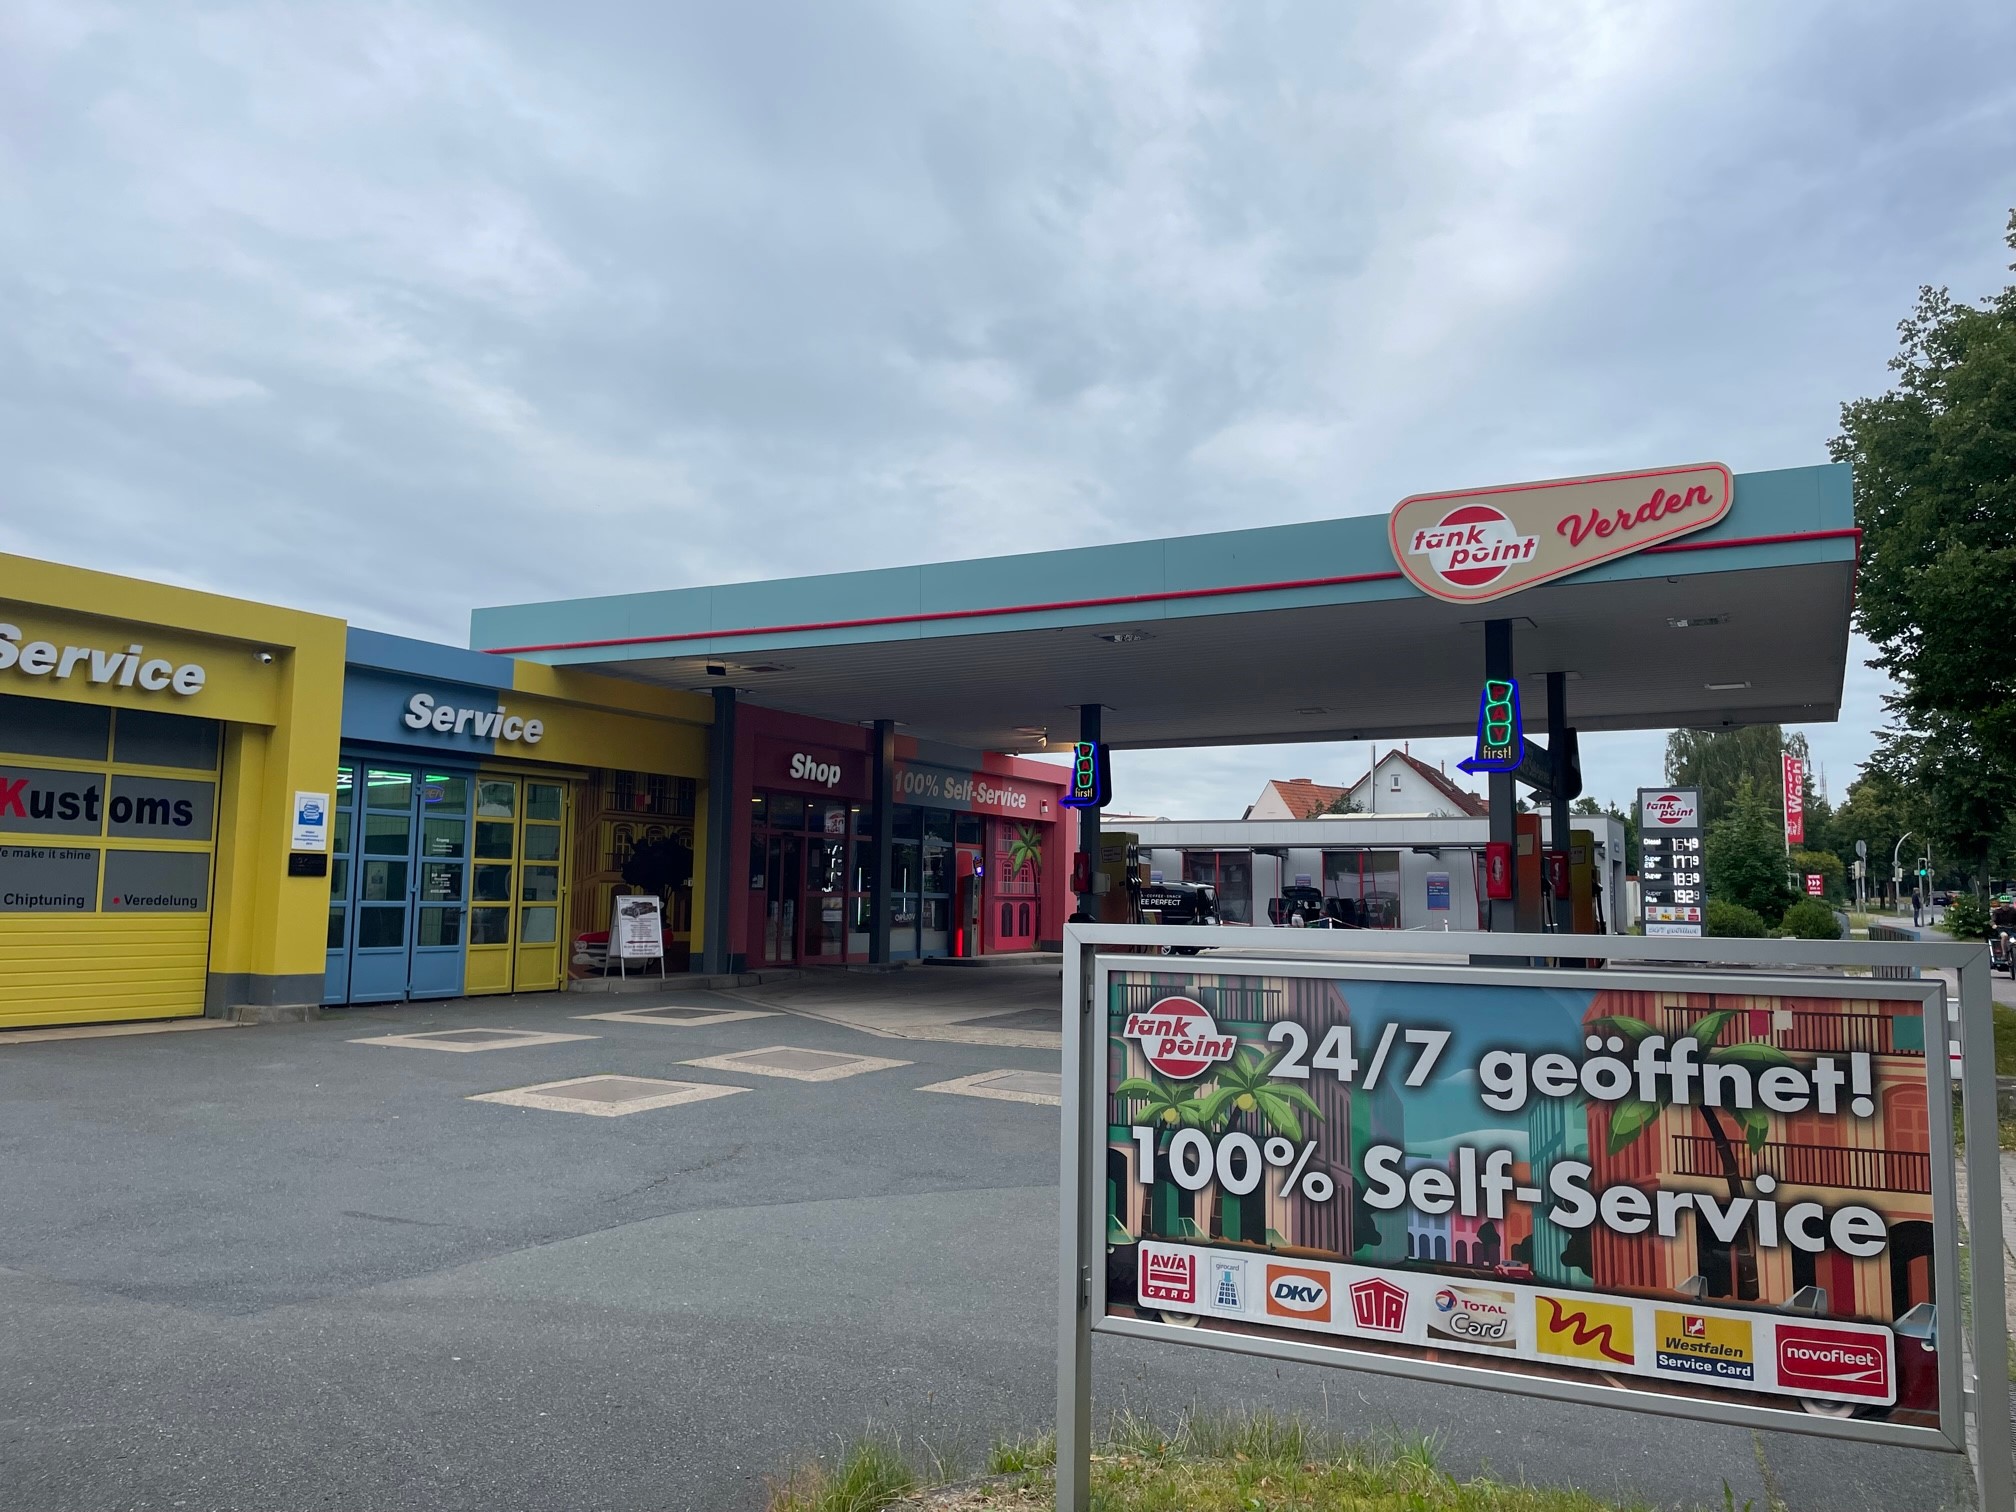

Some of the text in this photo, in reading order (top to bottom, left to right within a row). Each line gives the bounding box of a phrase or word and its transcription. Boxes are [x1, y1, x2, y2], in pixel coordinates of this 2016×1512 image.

[1556, 485, 1713, 548] Verden
[1414, 524, 1487, 551] tank
[1448, 537, 1536, 570] point
[0, 623, 206, 696] Service
[404, 693, 545, 744] Service
[1483, 744, 1513, 760] first!
[789, 752, 842, 789] Shop
[894, 770, 1027, 809] 100% Self-Service
[1075, 787, 1093, 798] first!
[1646, 802, 1675, 810] tank
[1660, 808, 1693, 818] point
[12, 848, 45, 860] make
[48, 850, 58, 860] it
[59, 849, 92, 861] shine
[1673, 872, 1700, 886] 1839
[4, 892, 199, 910] Chiptuning Veredelung
[1673, 889, 1700, 903] 1929
[1127, 1014, 1189, 1037] tank
[1157, 1033, 1235, 1058] point
[1267, 1020, 1876, 1118] 24/7 geöffnet!
[1131, 1125, 1888, 1258] 100% Self-Service
[1215, 1262, 1240, 1272] girocard
[1147, 1286, 1190, 1300] CARD
[1274, 1282, 1324, 1304] DKV
[1353, 1280, 1404, 1330] UTA
[1450, 1312, 1508, 1339] Card
[1665, 1336, 1744, 1359] Westfalen
[1658, 1354, 1752, 1378] Service Card
